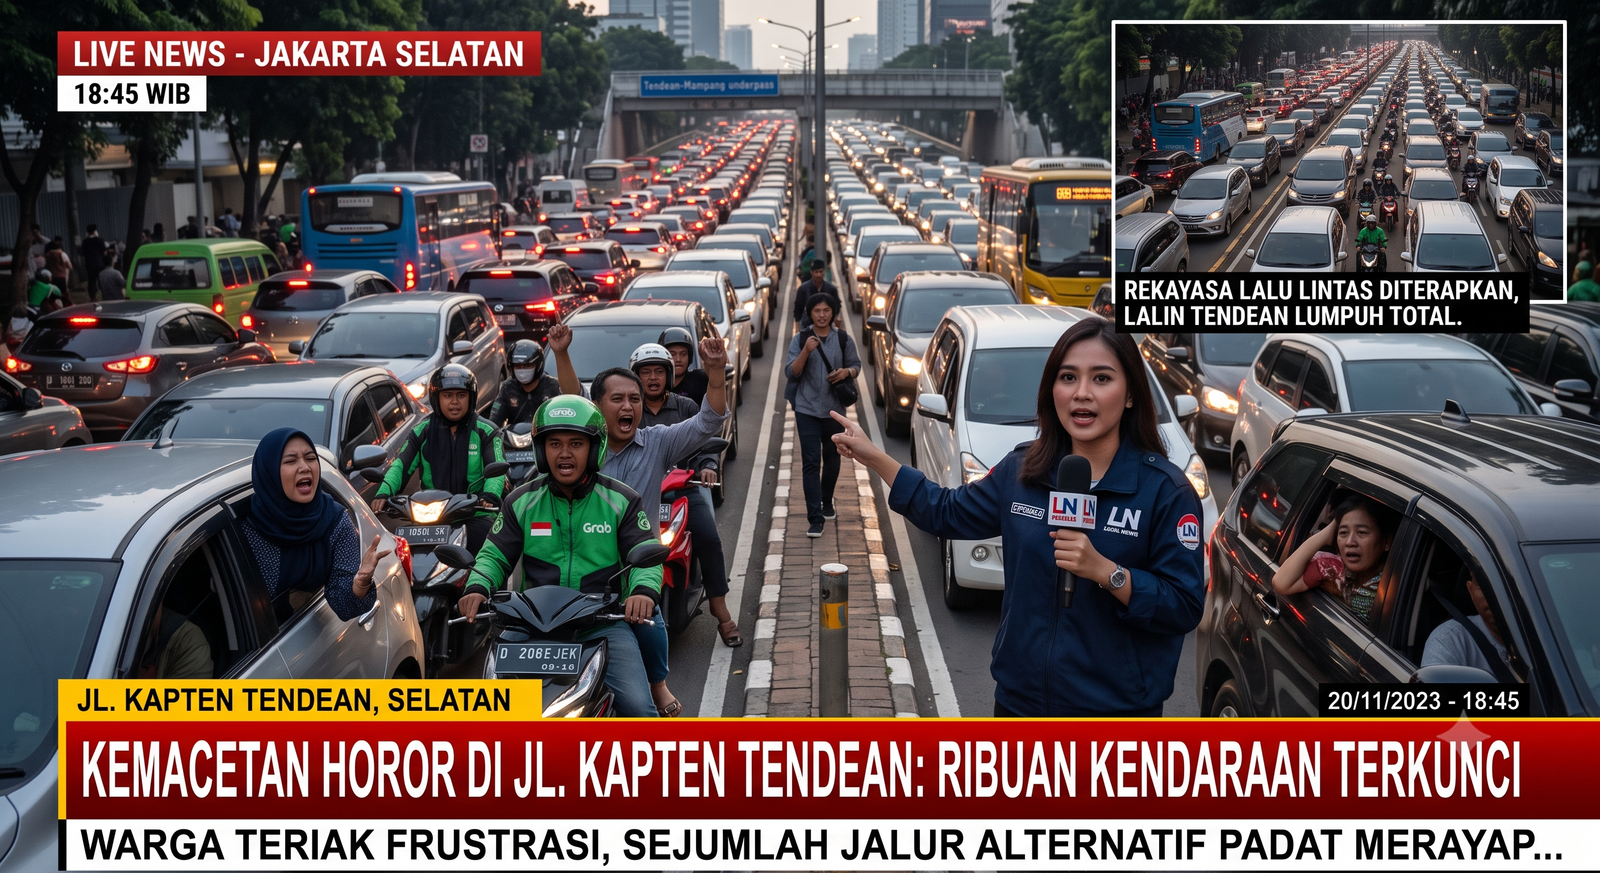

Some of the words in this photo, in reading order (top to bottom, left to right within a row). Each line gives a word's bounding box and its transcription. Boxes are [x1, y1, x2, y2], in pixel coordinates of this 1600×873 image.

[643, 81, 726, 92] Tendean-Mampang
[728, 80, 775, 92] underpass
[1053, 496, 1078, 516] LN
[1083, 499, 1096, 518] LN
[1106, 506, 1142, 531] LN
[583, 521, 612, 534] Grab
[1183, 524, 1197, 537] LN
[500, 647, 508, 659] D
[541, 663, 575, 671] 09-16
